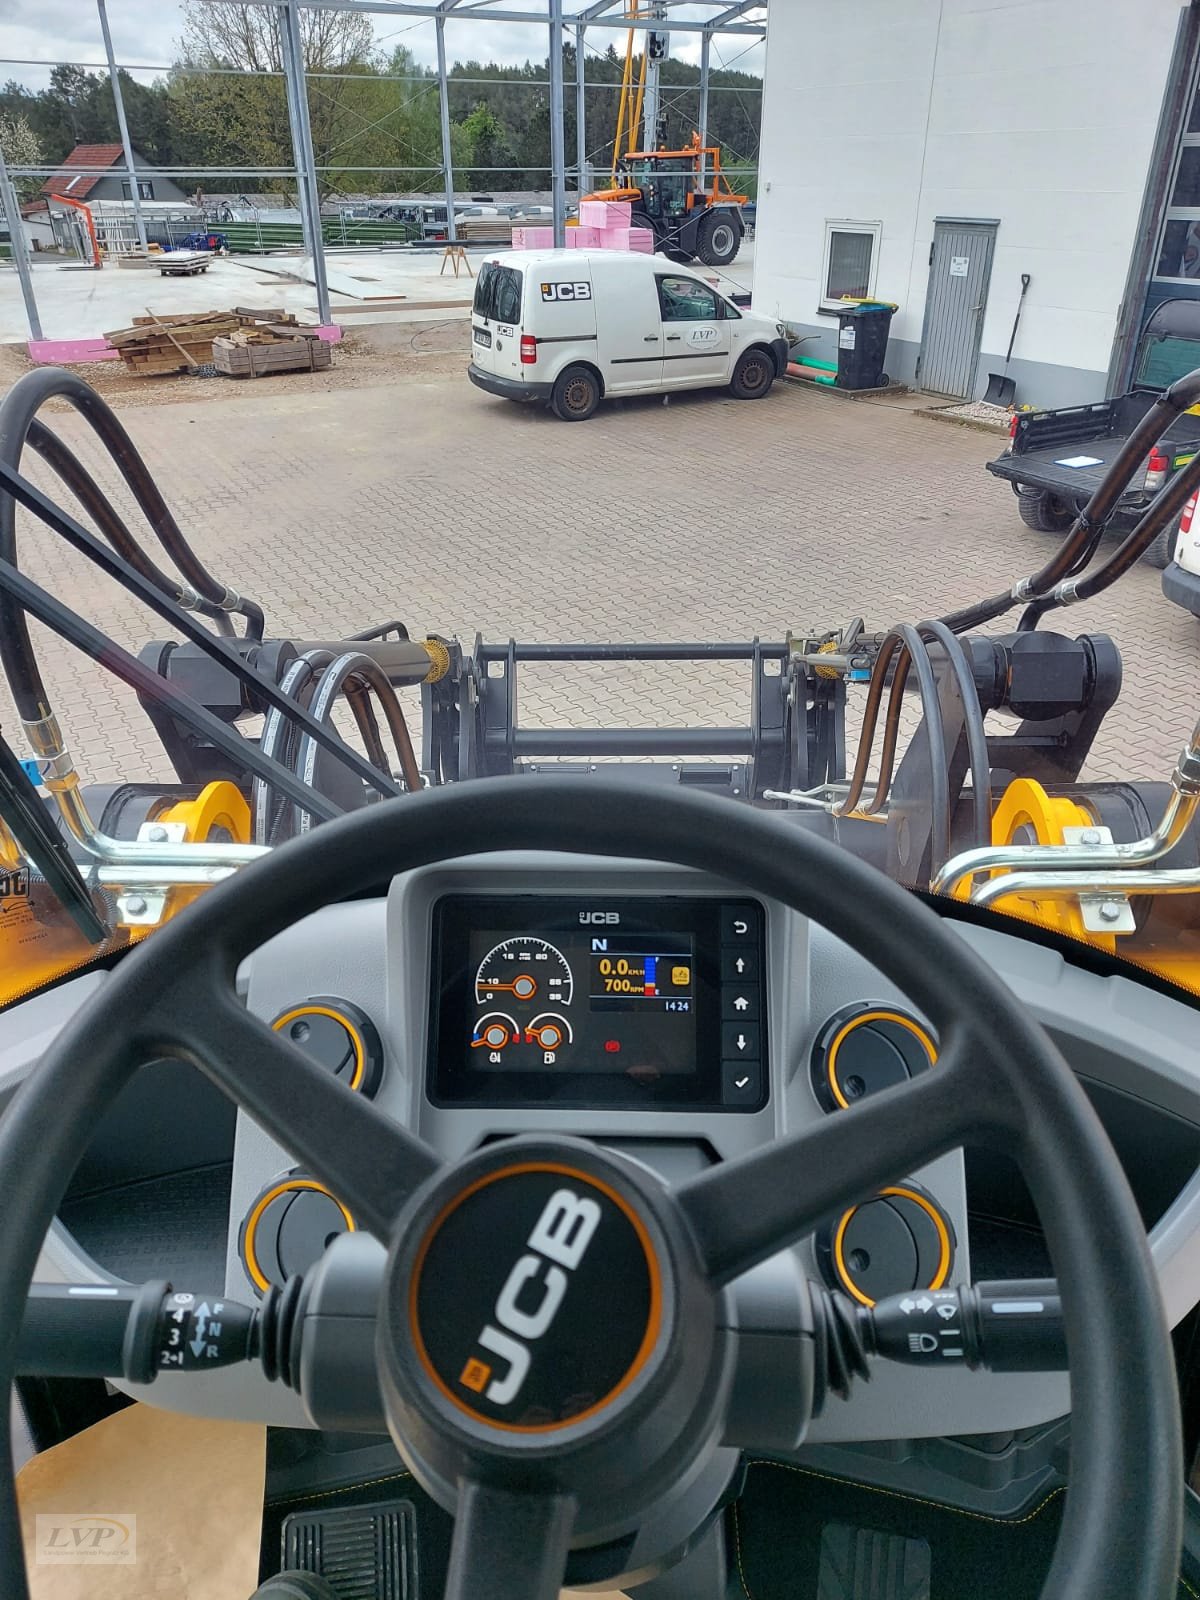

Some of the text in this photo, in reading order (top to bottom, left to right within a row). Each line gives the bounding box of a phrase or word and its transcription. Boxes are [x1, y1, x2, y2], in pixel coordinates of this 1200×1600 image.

[541, 282, 590, 301] JCB
[579, 911, 620, 924] JCB
[592, 938, 607, 951] N
[599, 958, 629, 975] 0.0
[604, 978, 631, 992] 700
[477, 1188, 602, 1405] JCB
[172, 1307, 184, 1323] 4
[213, 1302, 224, 1315] F
[168, 1328, 180, 1346] 3
[209, 1322, 221, 1337] N
[206, 1344, 218, 1358] R
